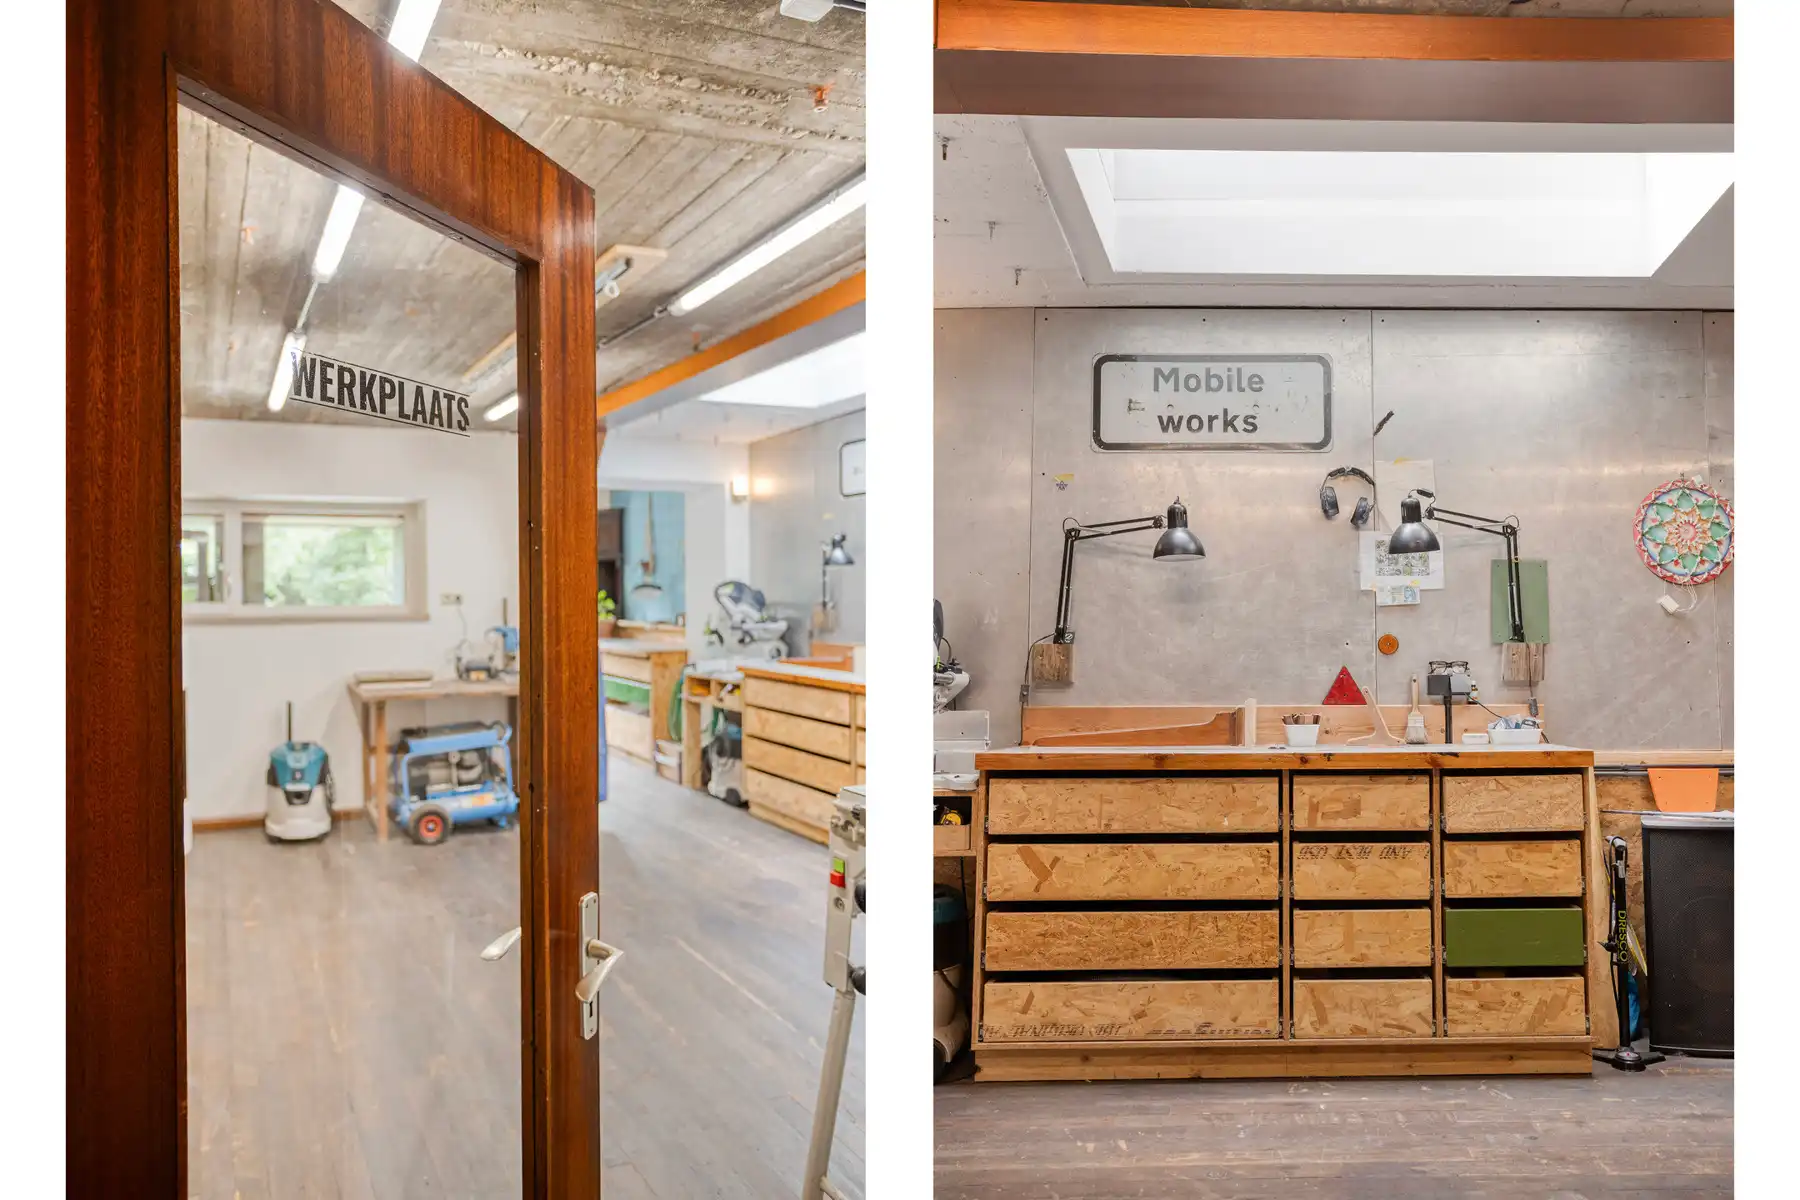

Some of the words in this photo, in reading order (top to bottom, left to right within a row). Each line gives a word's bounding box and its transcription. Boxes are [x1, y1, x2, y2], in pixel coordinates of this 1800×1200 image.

[290, 351, 470, 431] WERKPLAATS
[1153, 367, 1265, 393] Mobile
[1157, 408, 1259, 434] works
[1618, 910, 1628, 962] DRESCO
